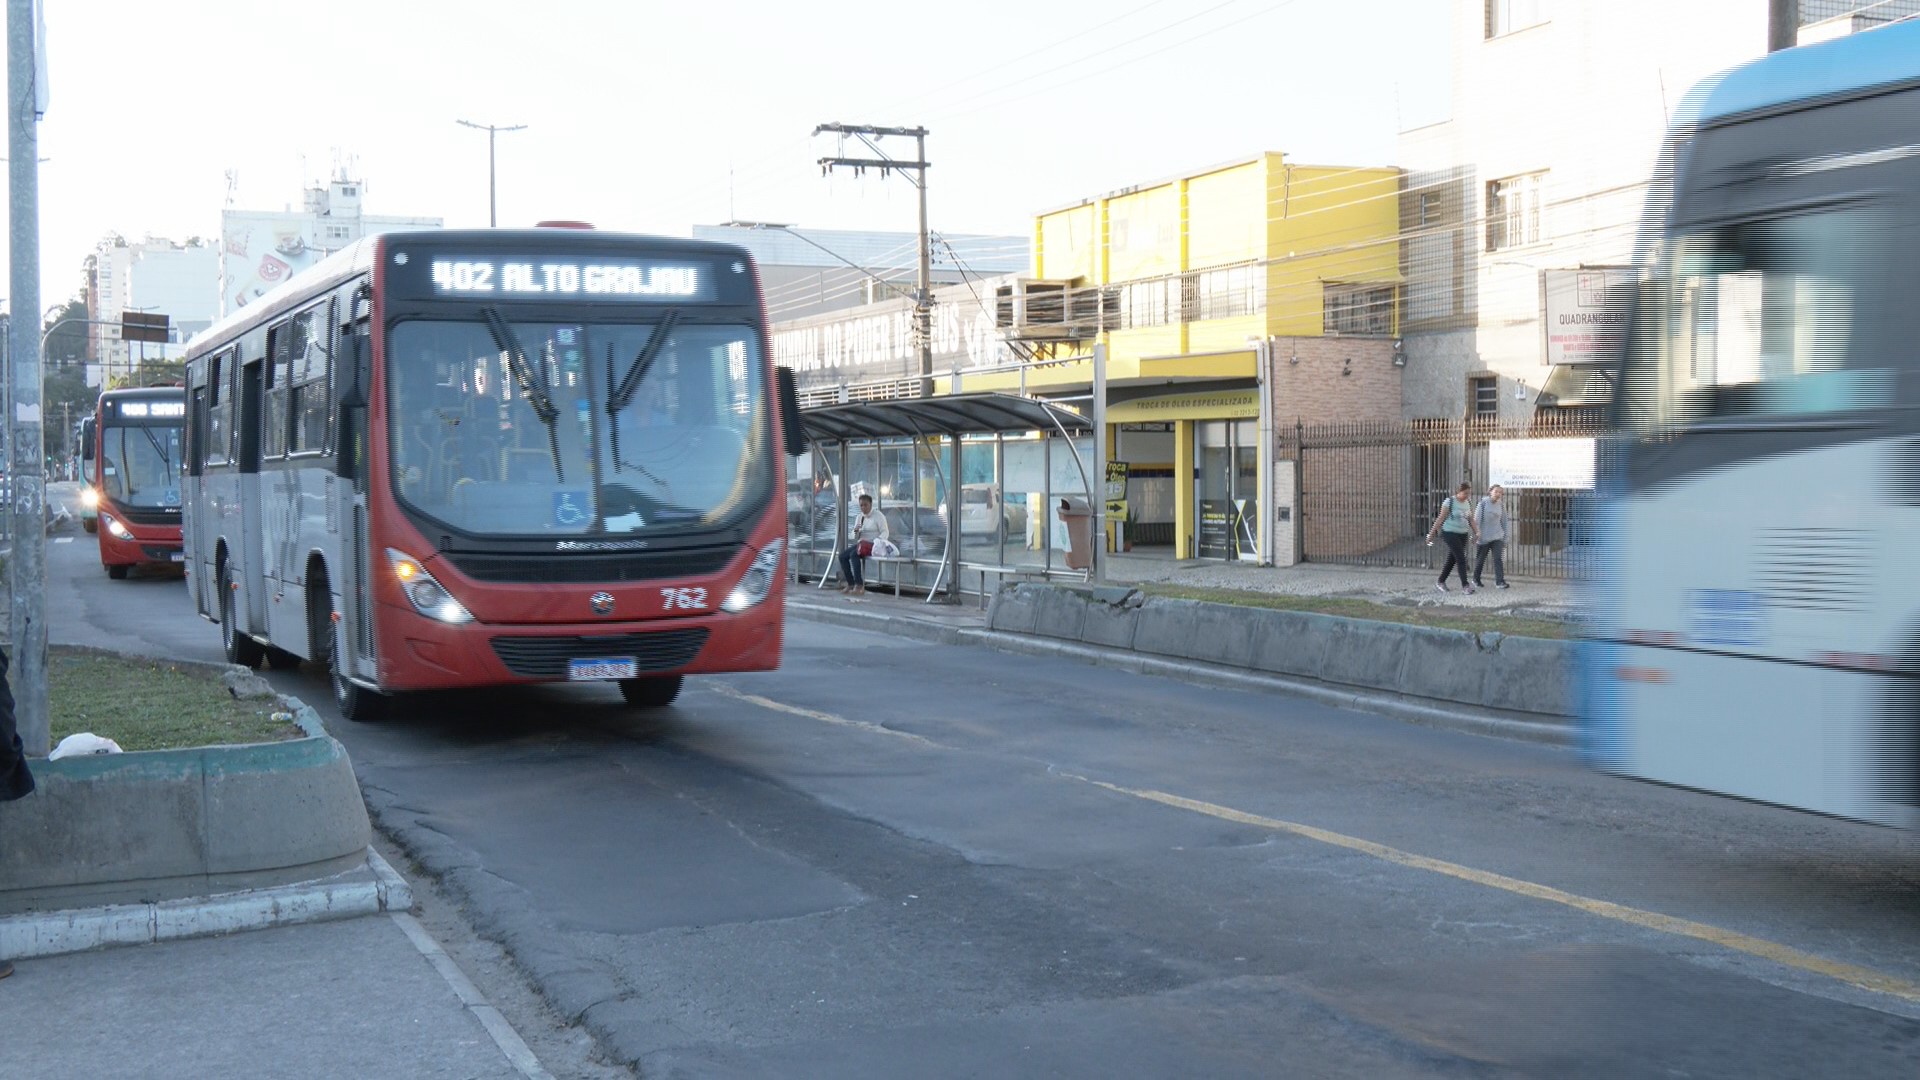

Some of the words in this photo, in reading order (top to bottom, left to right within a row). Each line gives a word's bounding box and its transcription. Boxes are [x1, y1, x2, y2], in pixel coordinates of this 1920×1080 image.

[431, 262, 493, 291] 402
[501, 263, 579, 293] ALTO
[1559, 312, 1626, 326] QUADRANGULAR
[823, 322, 842, 368] DO
[845, 314, 891, 366] PODER
[930, 302, 960, 354] EUS
[151, 404, 185, 415] SANT
[1136, 401, 1159, 409] TROCA
[1192, 396, 1253, 407] ESPECIALIZADA
[556, 541, 648, 551] Marcopolo
[660, 587, 709, 610] 762
